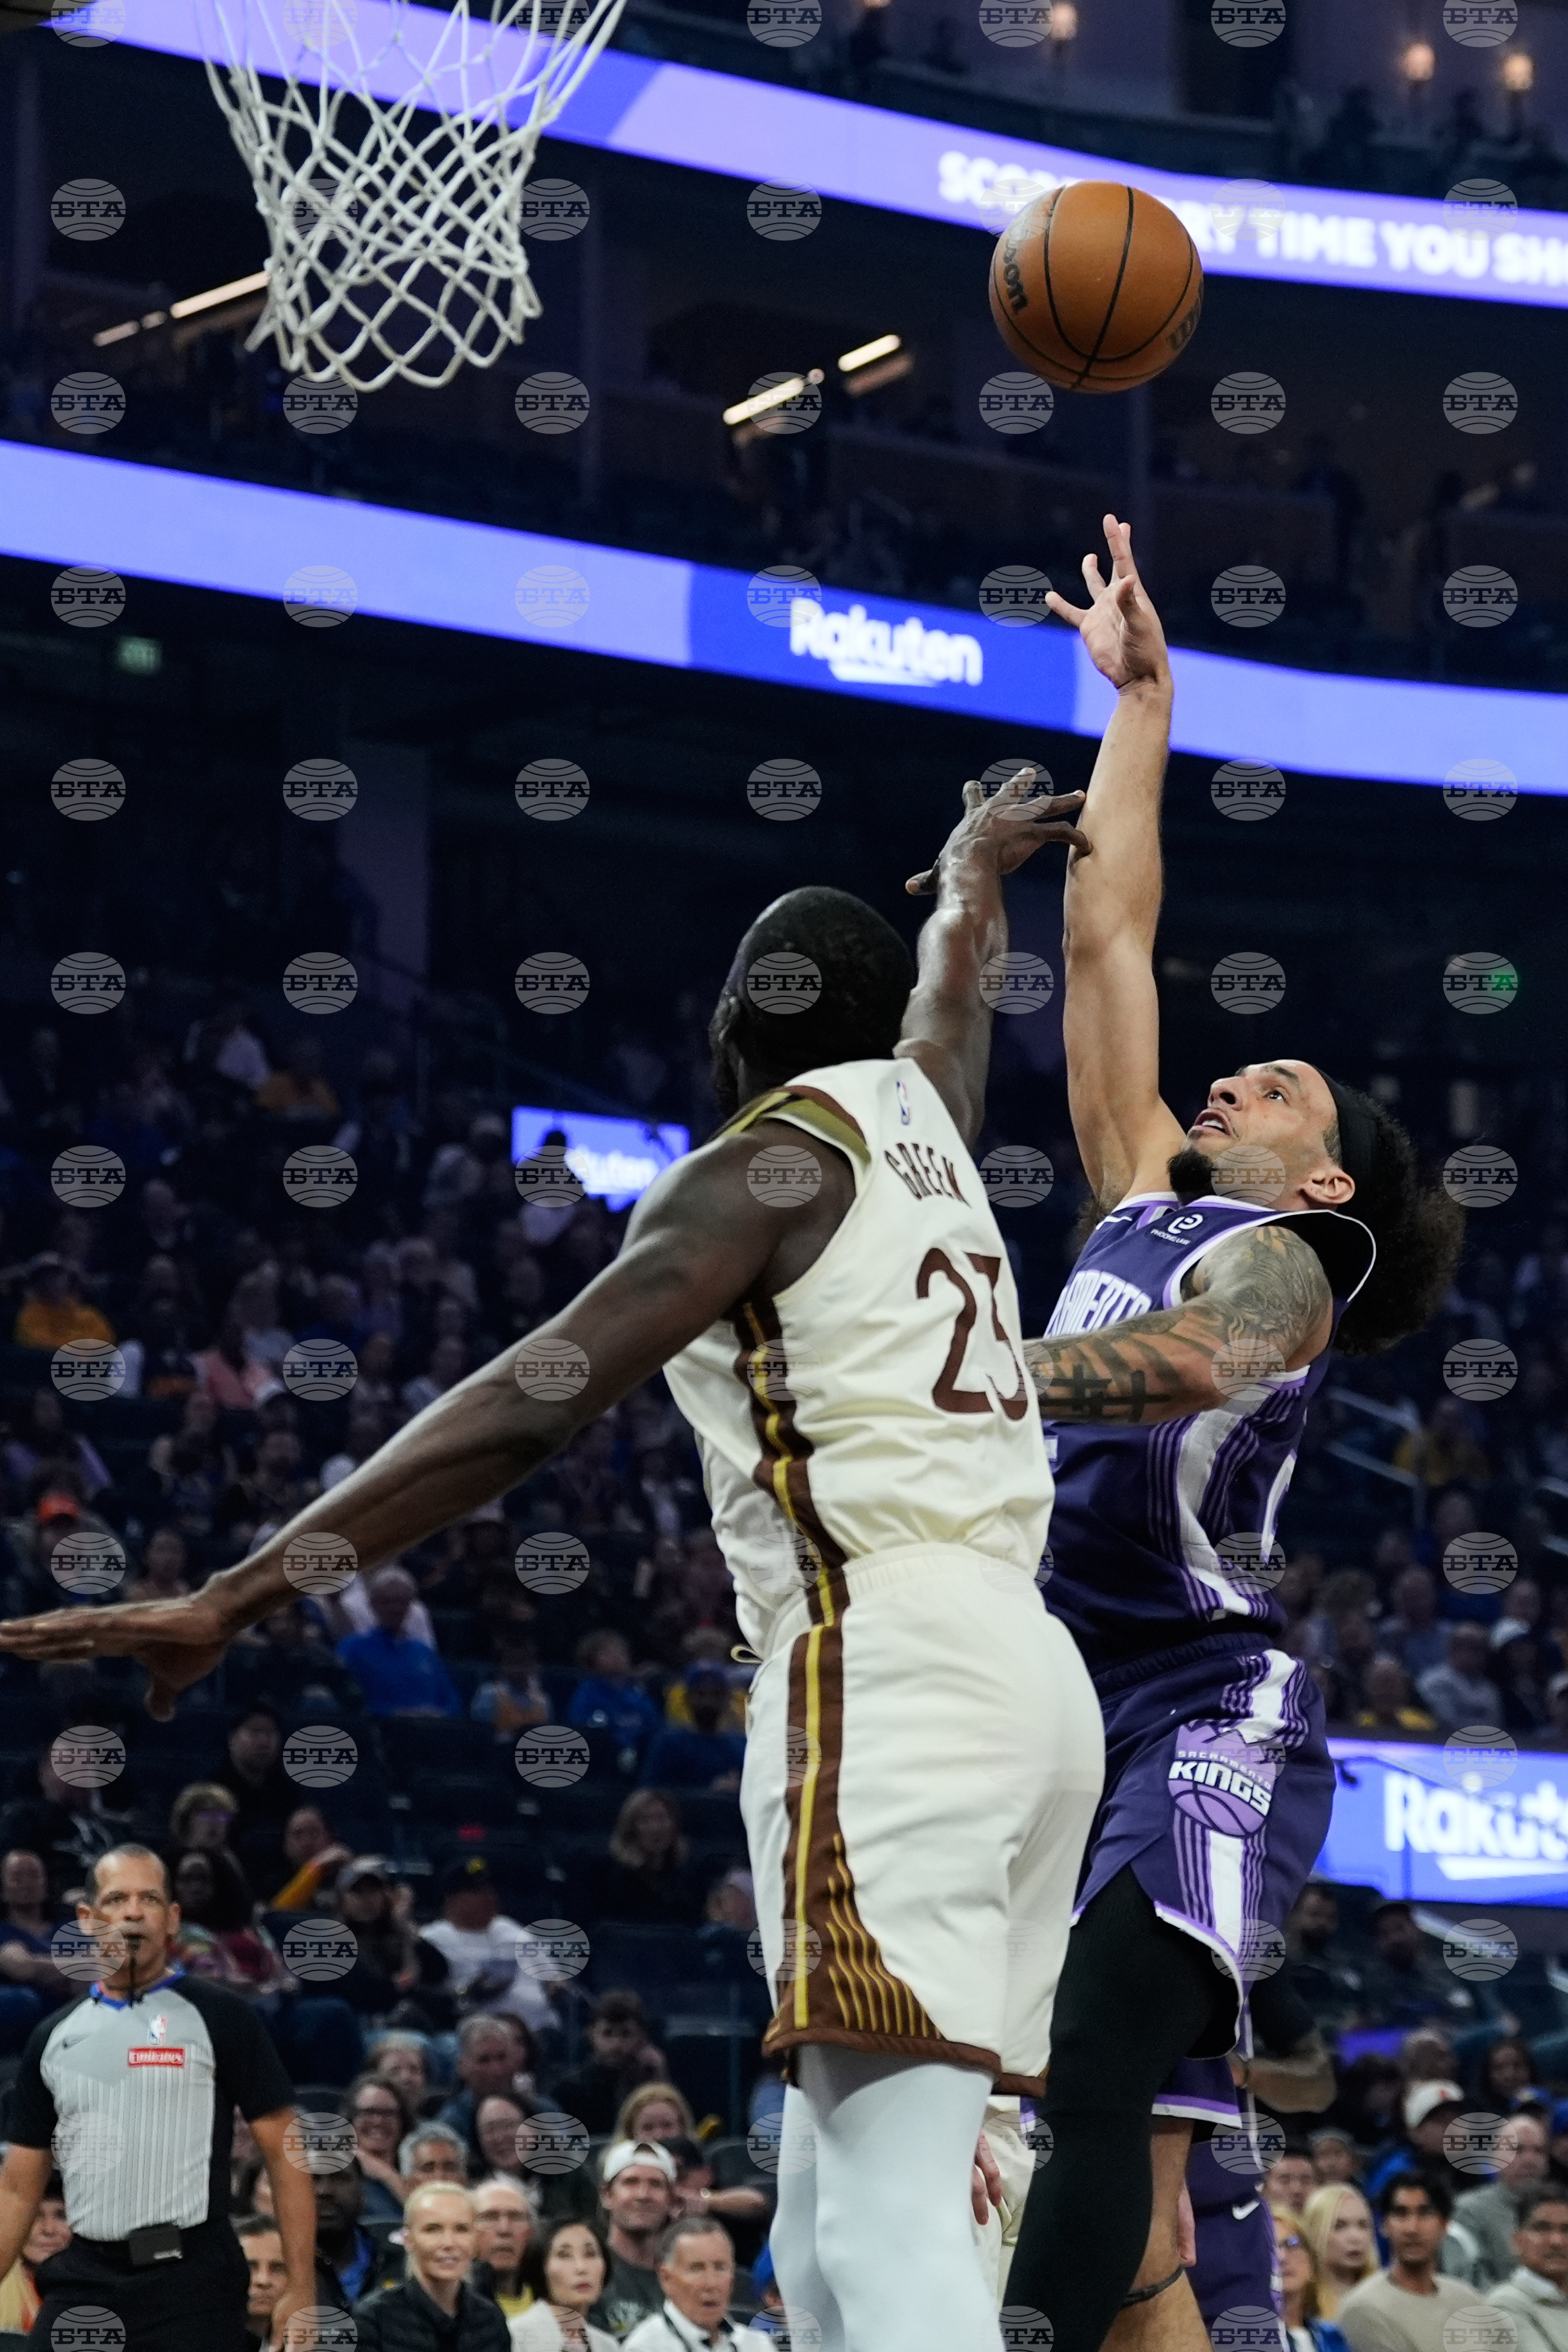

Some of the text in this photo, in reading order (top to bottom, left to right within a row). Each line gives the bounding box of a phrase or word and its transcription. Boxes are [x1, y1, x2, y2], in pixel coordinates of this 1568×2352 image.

[938, 150, 1076, 216] SCO
[1248, 205, 1377, 268] TIME
[1379, 220, 1490, 280] YOU
[790, 598, 983, 686] Rakuten
[884, 1143, 972, 1208] GREEN
[916, 1247, 1028, 1421] 23
[1168, 1760, 1272, 1816] KINGS
[1177, 1750, 1272, 1790] SACRAMENTO
[1384, 1772, 1568, 1861] Rakut
